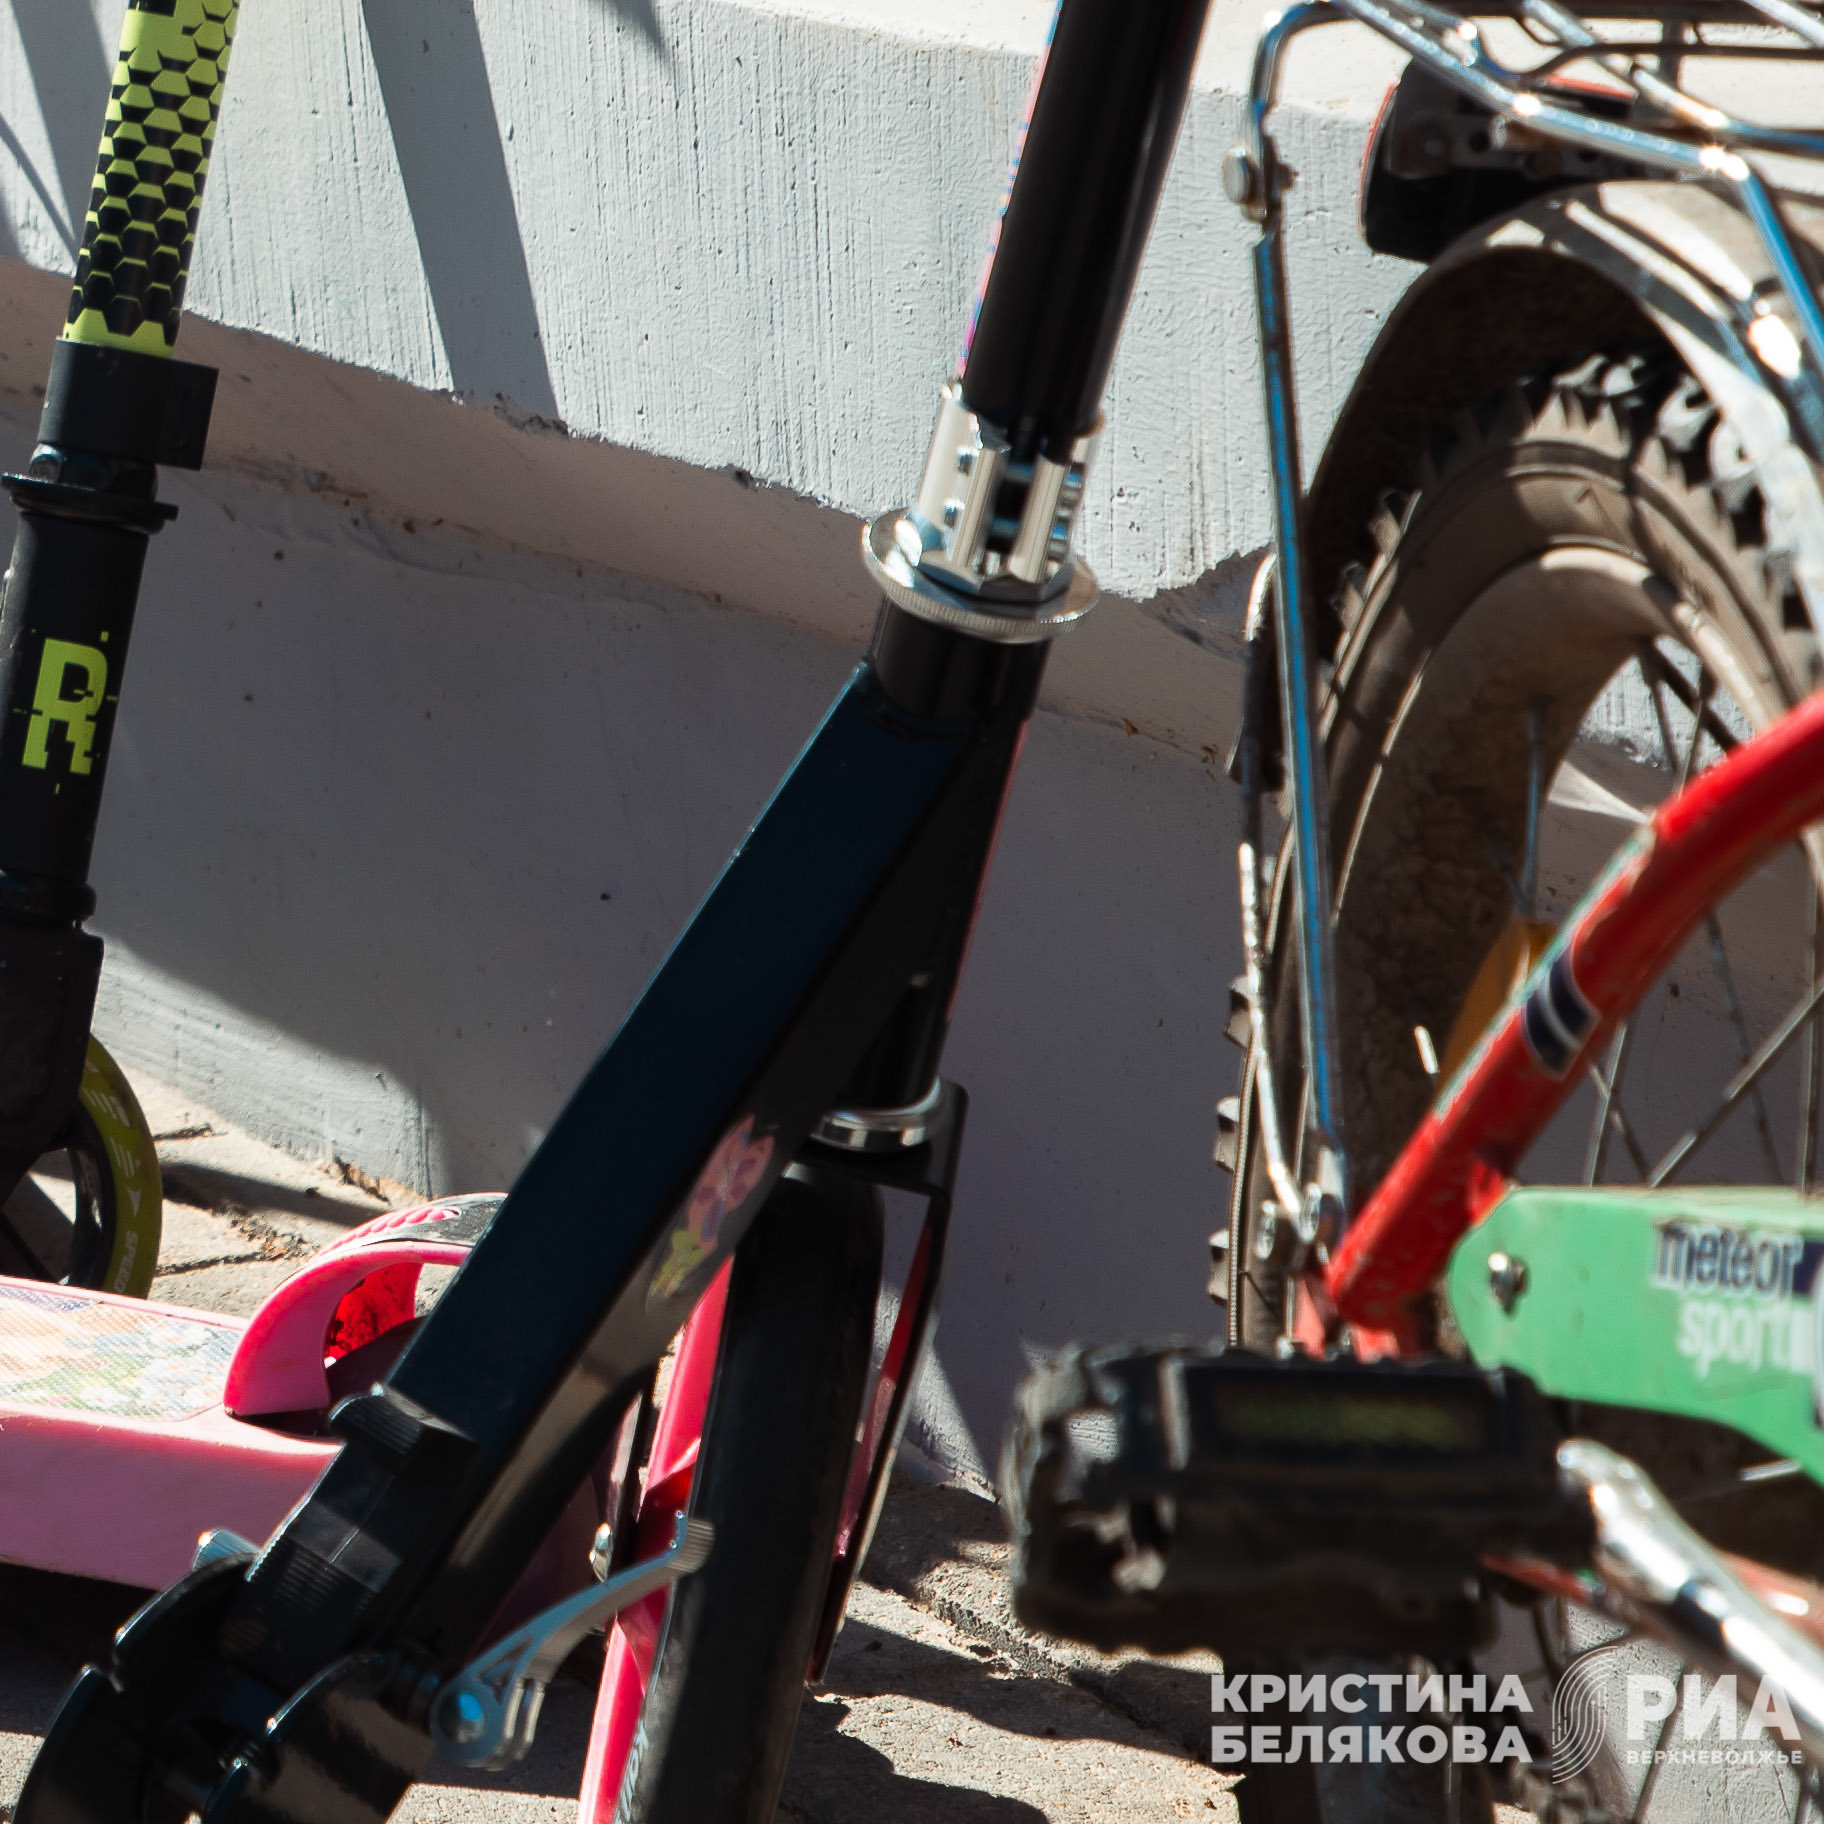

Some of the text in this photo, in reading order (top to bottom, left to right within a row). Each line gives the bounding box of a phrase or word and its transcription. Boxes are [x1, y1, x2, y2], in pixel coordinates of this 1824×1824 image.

[22, 638, 108, 776] R
[114, 1230, 139, 1293] SPEED
[1654, 1220, 1802, 1300] meteor
